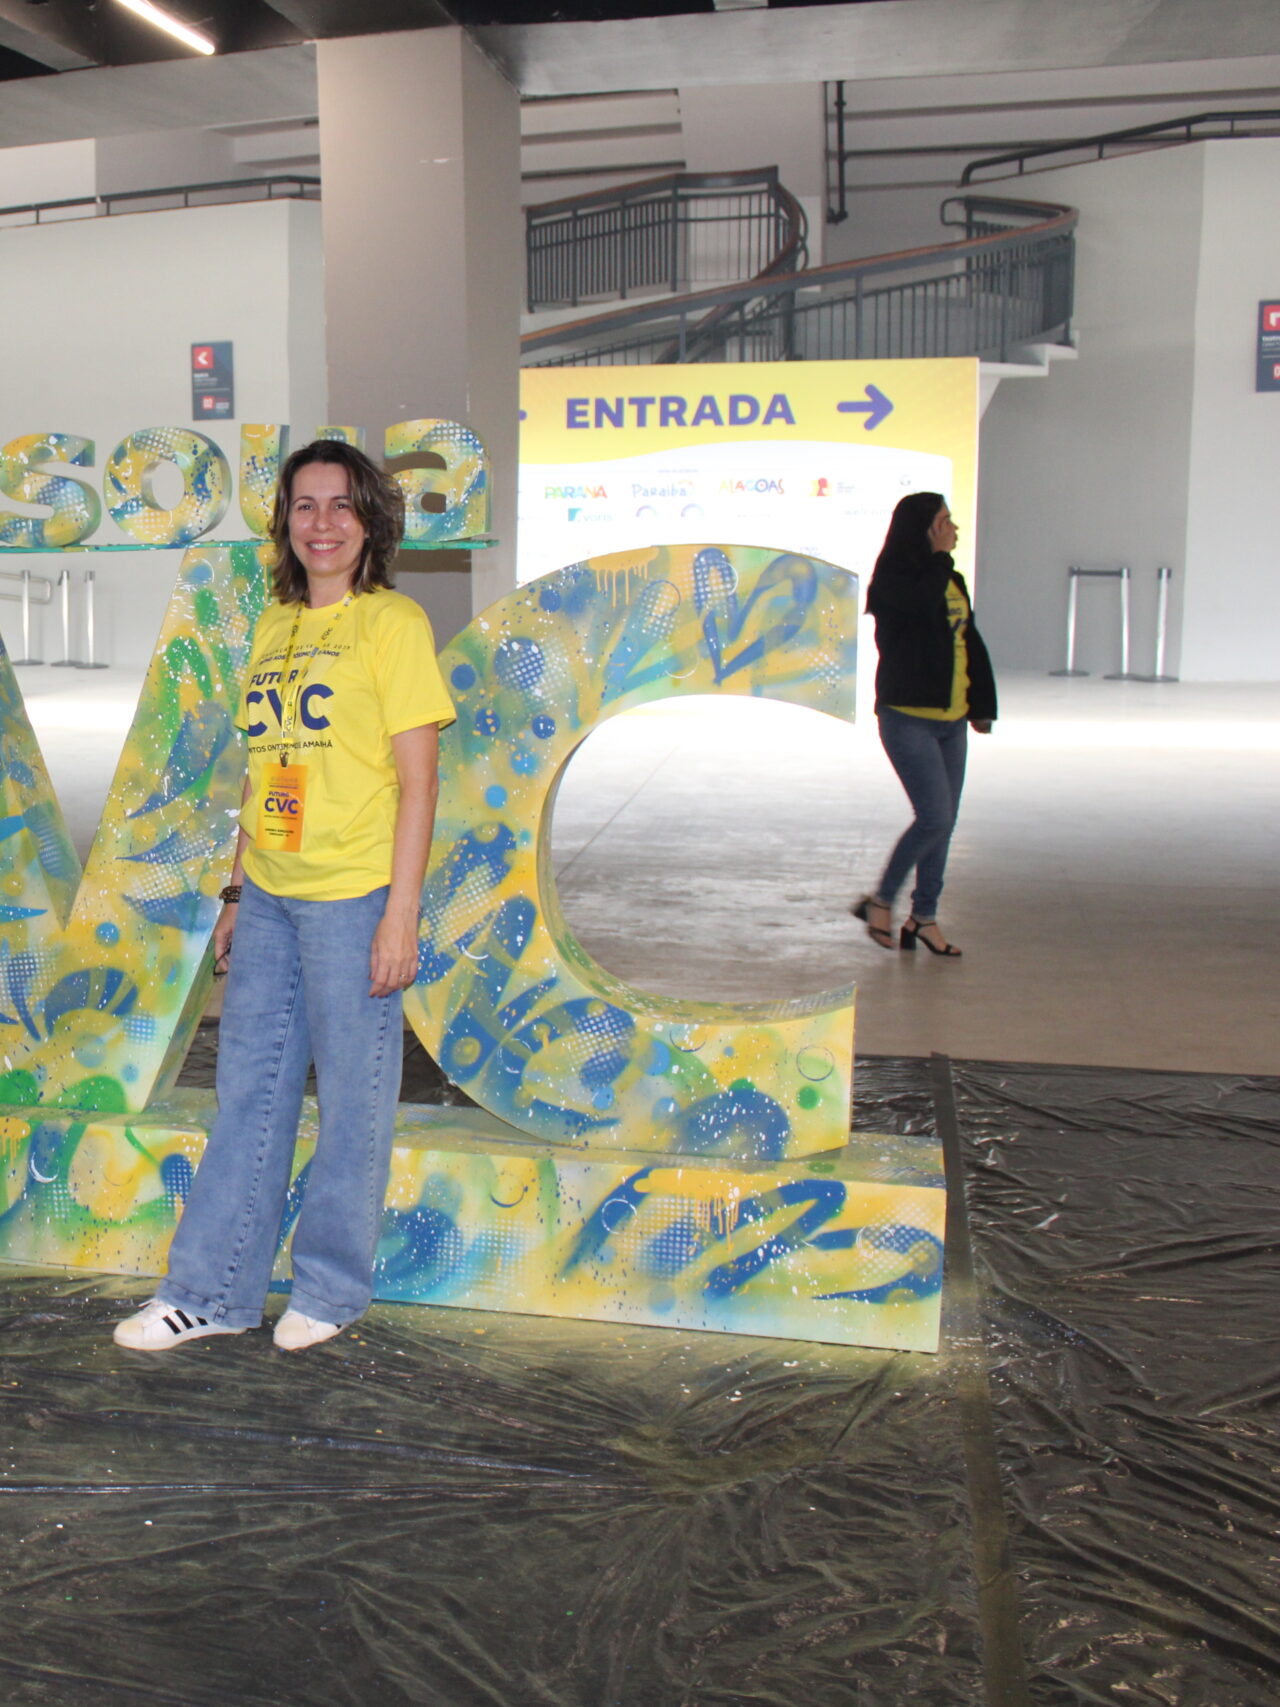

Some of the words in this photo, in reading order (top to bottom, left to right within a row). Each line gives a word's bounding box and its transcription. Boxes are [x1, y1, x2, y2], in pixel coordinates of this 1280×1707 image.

[566, 394, 796, 429] ENTRADA
[246, 684, 334, 737] CVC
[264, 797, 299, 814] CVC
